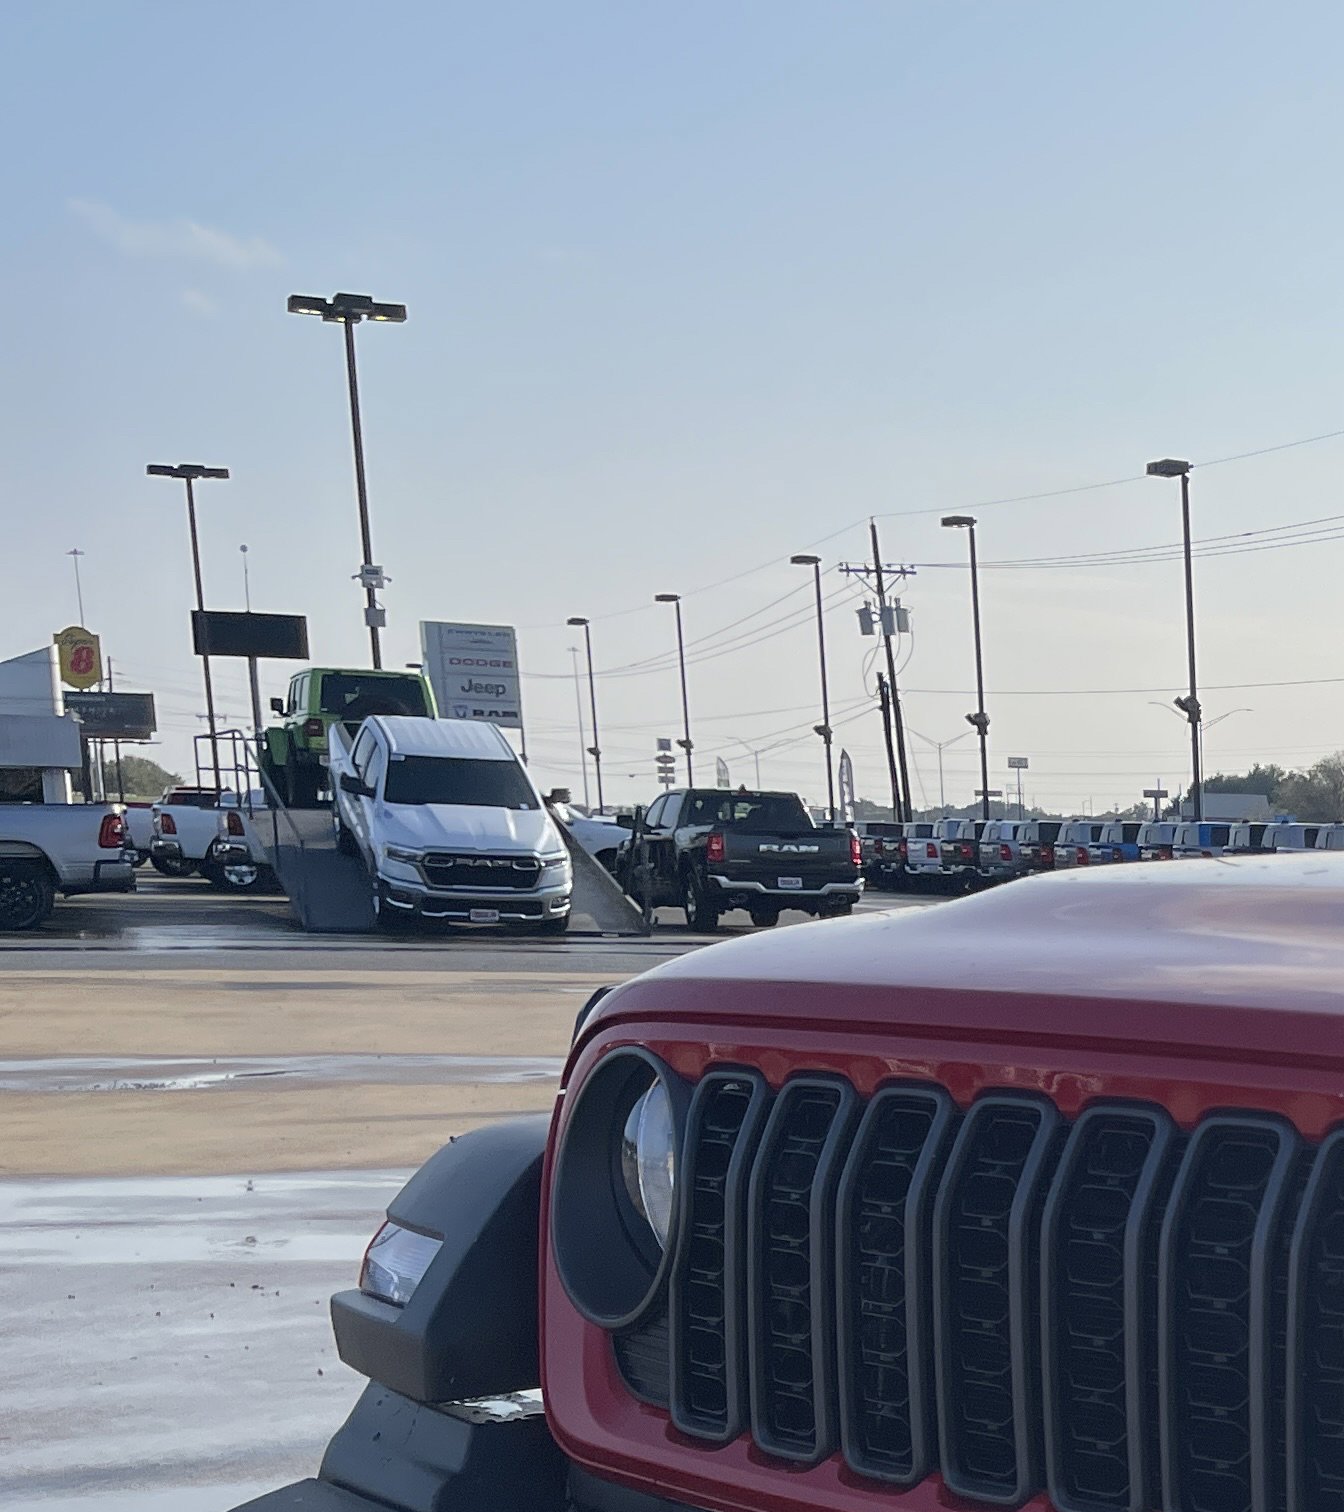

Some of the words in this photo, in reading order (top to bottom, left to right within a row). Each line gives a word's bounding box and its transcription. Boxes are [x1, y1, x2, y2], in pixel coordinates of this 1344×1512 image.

[69, 645, 95, 675] 8
[449, 657, 513, 669] DODGE
[460, 678, 507, 698] Jeep
[472, 708, 519, 718] RAM
[759, 844, 819, 854] RAM
